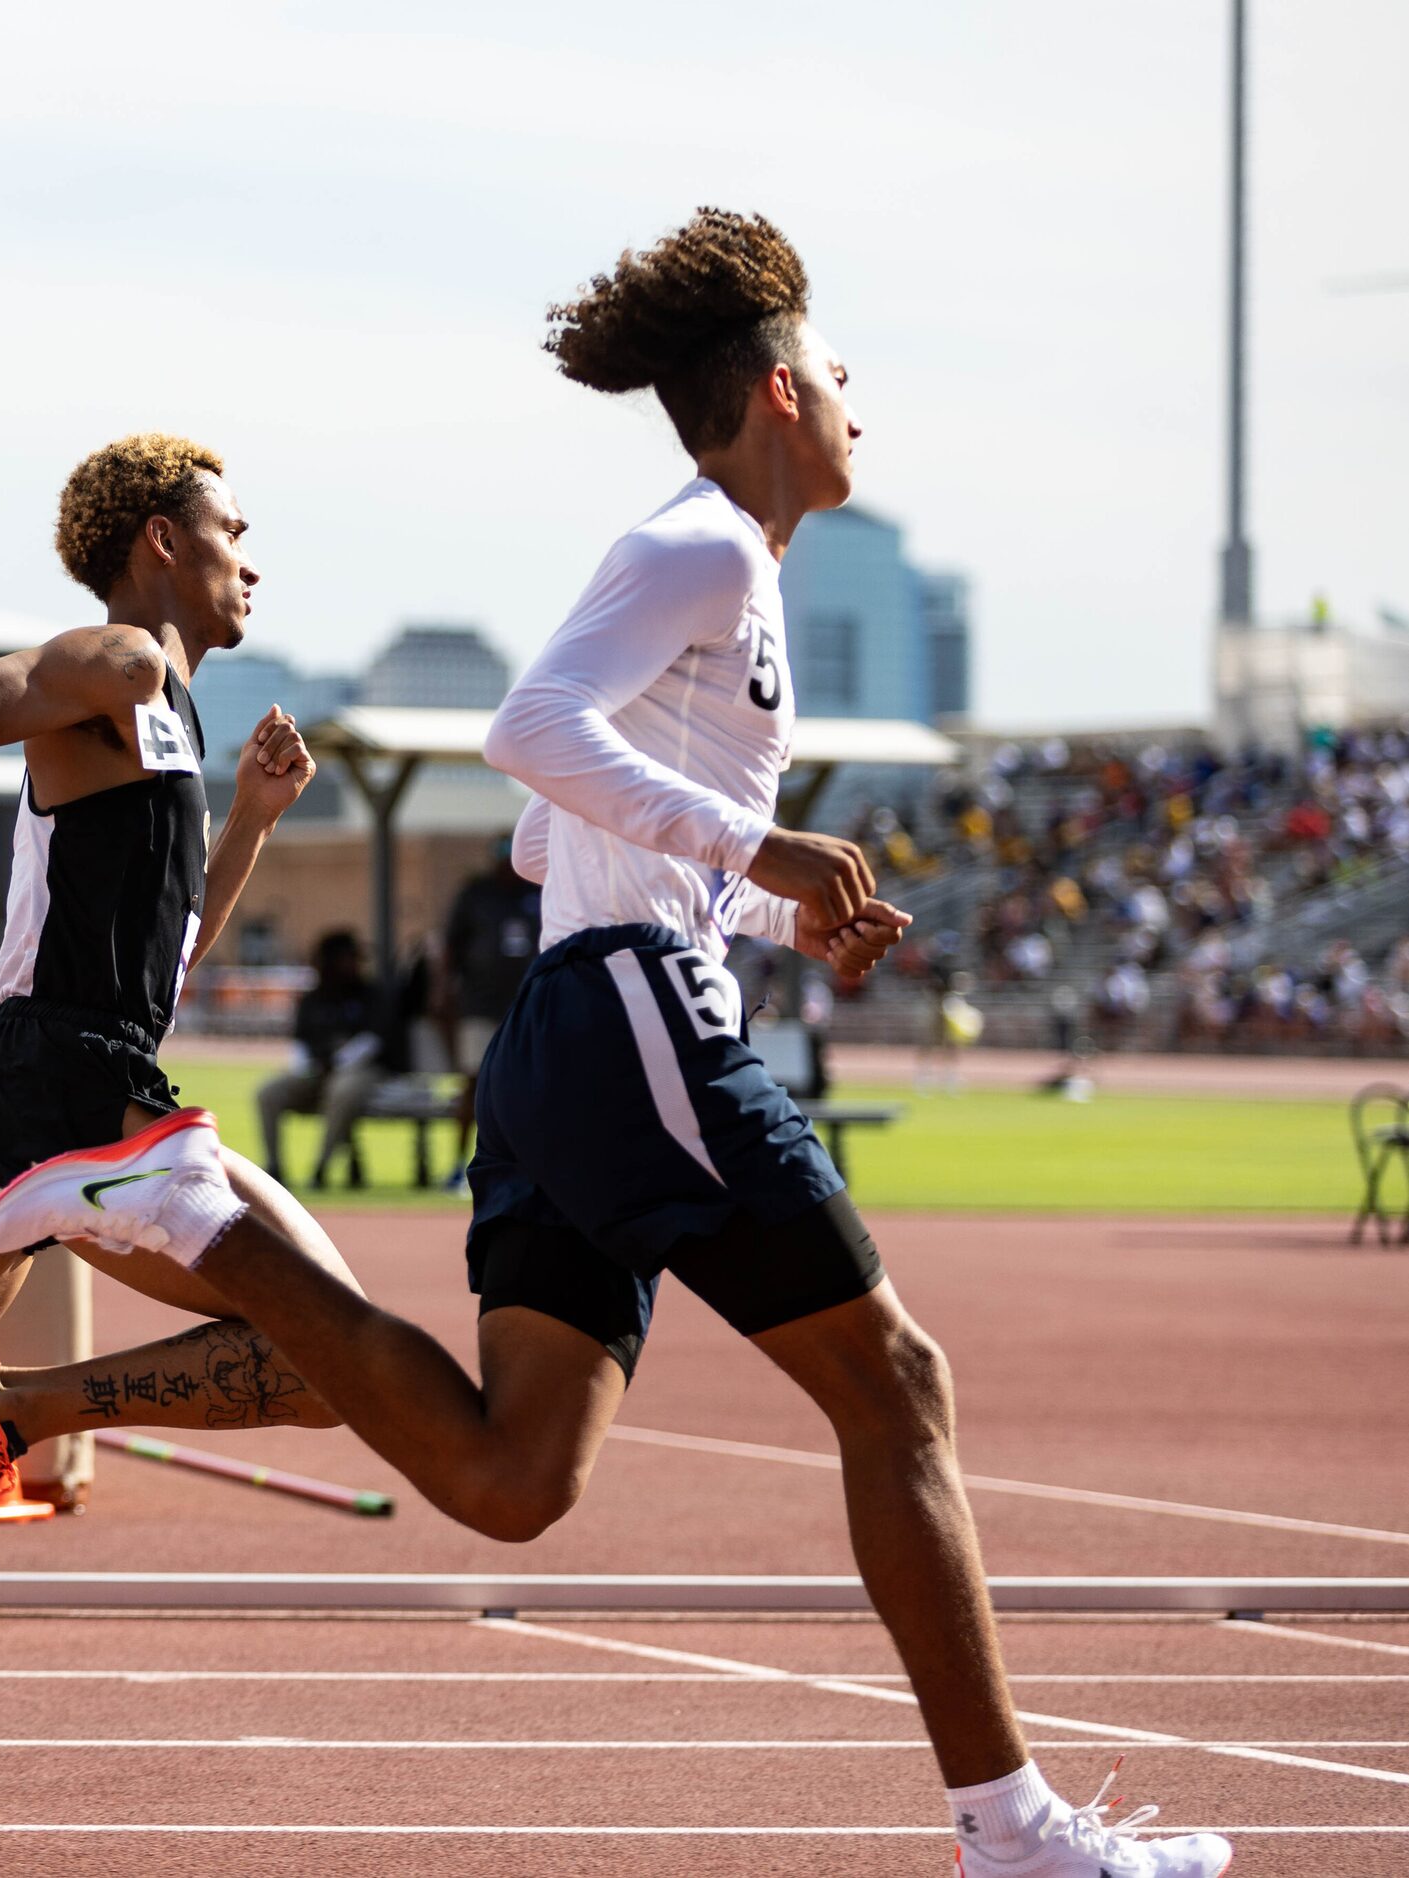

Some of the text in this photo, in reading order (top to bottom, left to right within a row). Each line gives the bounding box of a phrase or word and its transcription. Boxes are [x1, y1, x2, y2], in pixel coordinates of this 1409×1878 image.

[748, 626, 781, 711] 5
[143, 713, 184, 760] 4
[675, 955, 737, 1028] 5
[79, 1371, 201, 1418] 克里斯
